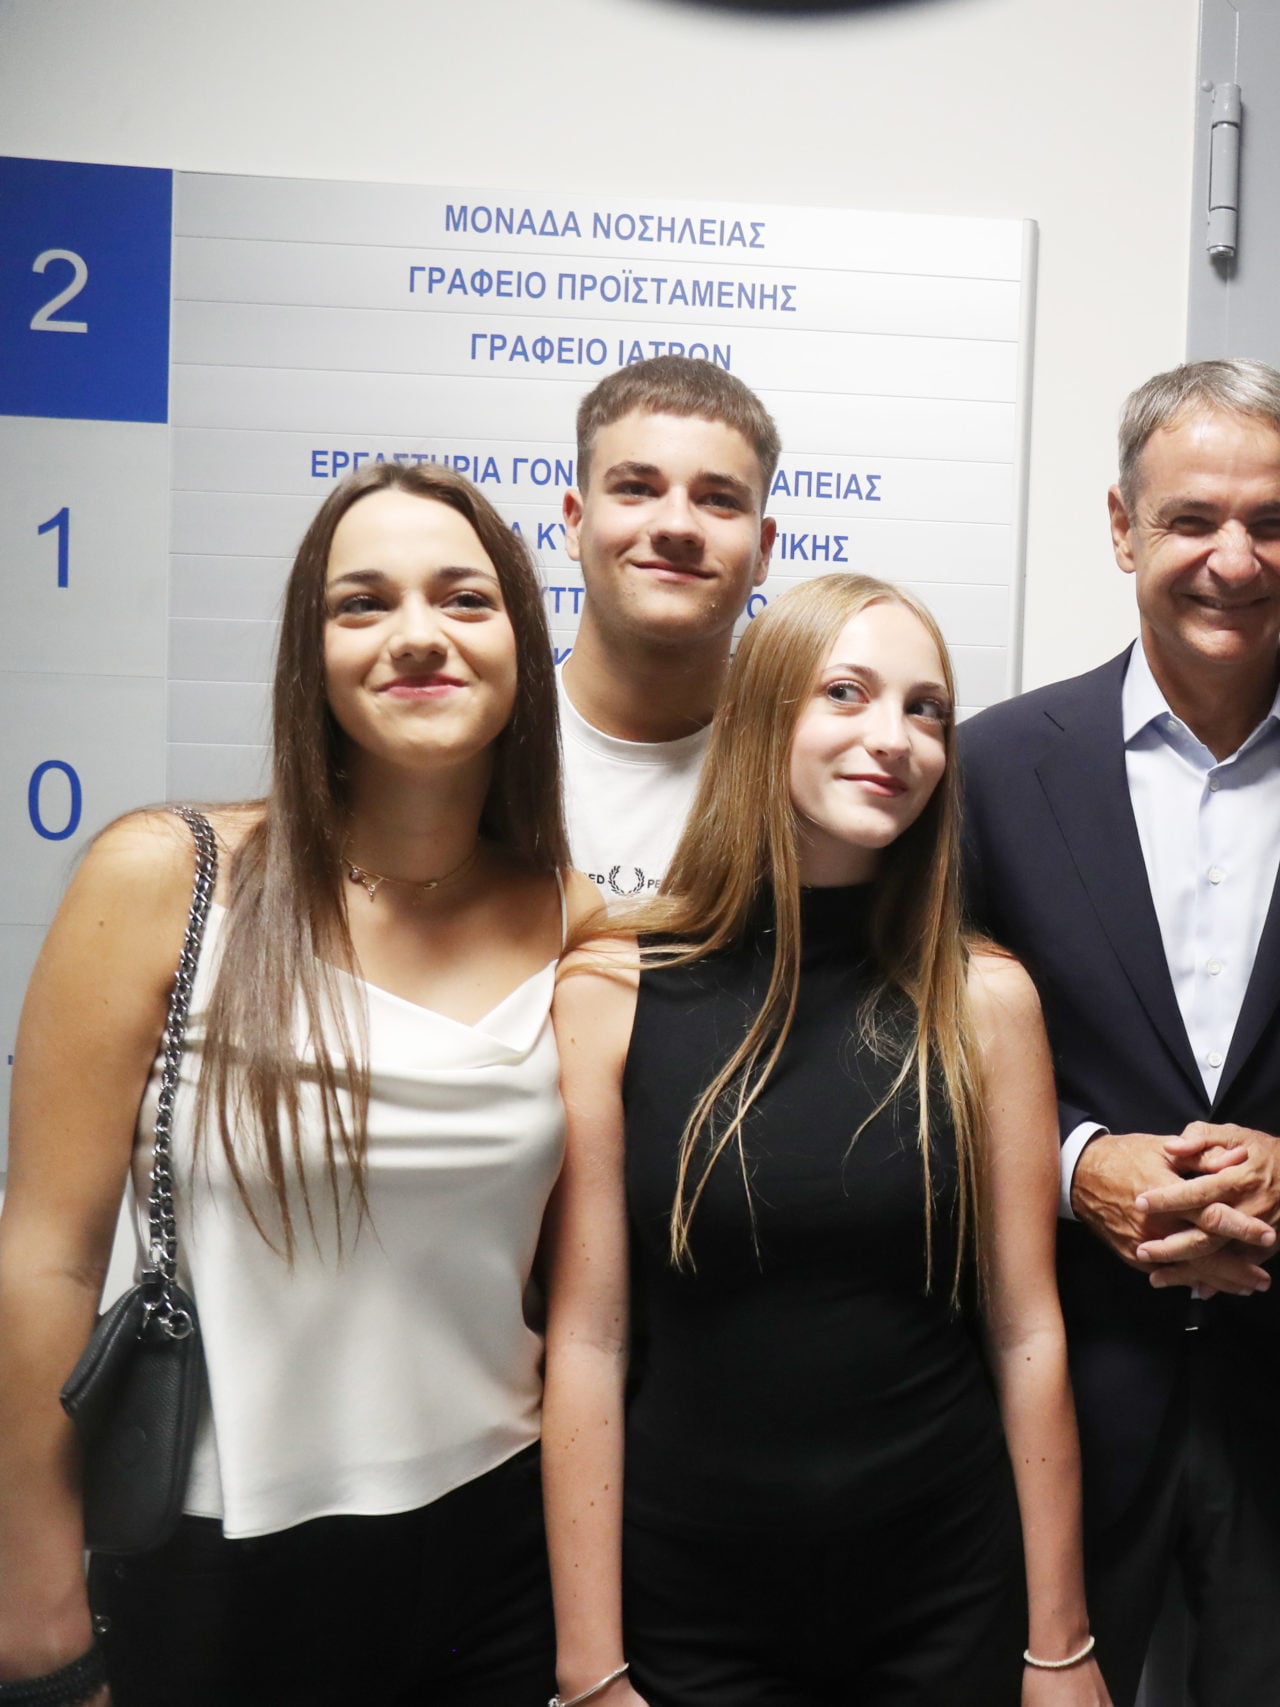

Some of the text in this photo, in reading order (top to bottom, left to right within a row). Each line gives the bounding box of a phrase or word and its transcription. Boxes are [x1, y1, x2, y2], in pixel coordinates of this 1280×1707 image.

[445, 204, 766, 249] ΜΟΝΑΔΑ ΝΟΣΗΛΕΙΑΣ
[30, 249, 88, 333] 2
[408, 265, 797, 312] ΓΡΑΦΕΙΟ ΠΡΟΪΣΤΑΜΕΝΗΣ
[470, 333, 608, 366] ΓΡΑΦΕΙΟ
[511, 457, 574, 488] ΓΟΝ
[770, 469, 882, 502] ΑΠΕΙΑΣ
[37, 506, 71, 589] 1
[27, 759, 84, 842] 0
